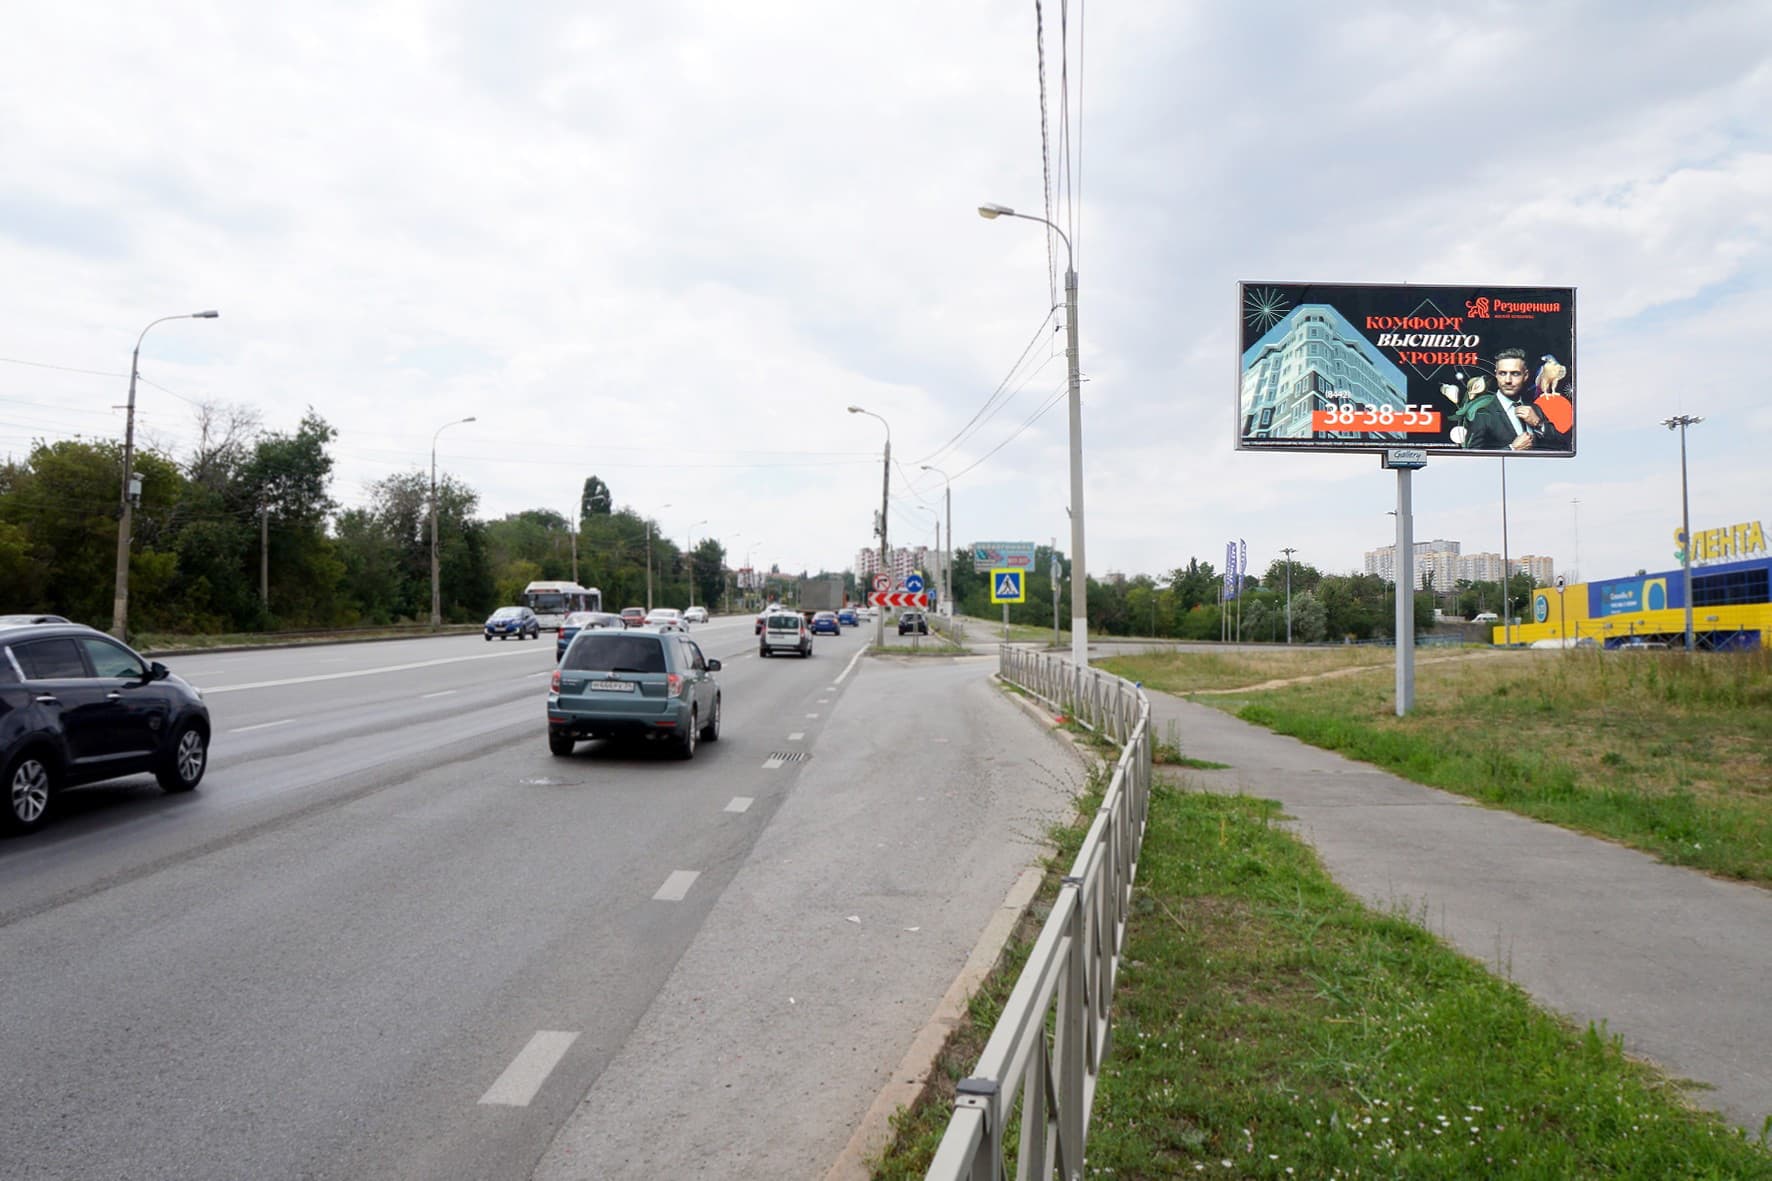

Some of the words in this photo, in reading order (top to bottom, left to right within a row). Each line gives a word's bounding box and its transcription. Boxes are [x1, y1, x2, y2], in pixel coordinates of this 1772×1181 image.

[1494, 298, 1560, 313] Резиденция
[1366, 316, 1463, 330] КОМФОРТ
[1377, 333, 1480, 348] ВЫСШЕГО
[1398, 351, 1478, 365] УРОВНЯ
[1323, 403, 1433, 426] 38-38-55
[1690, 520, 1767, 562] ЛЕНТА
